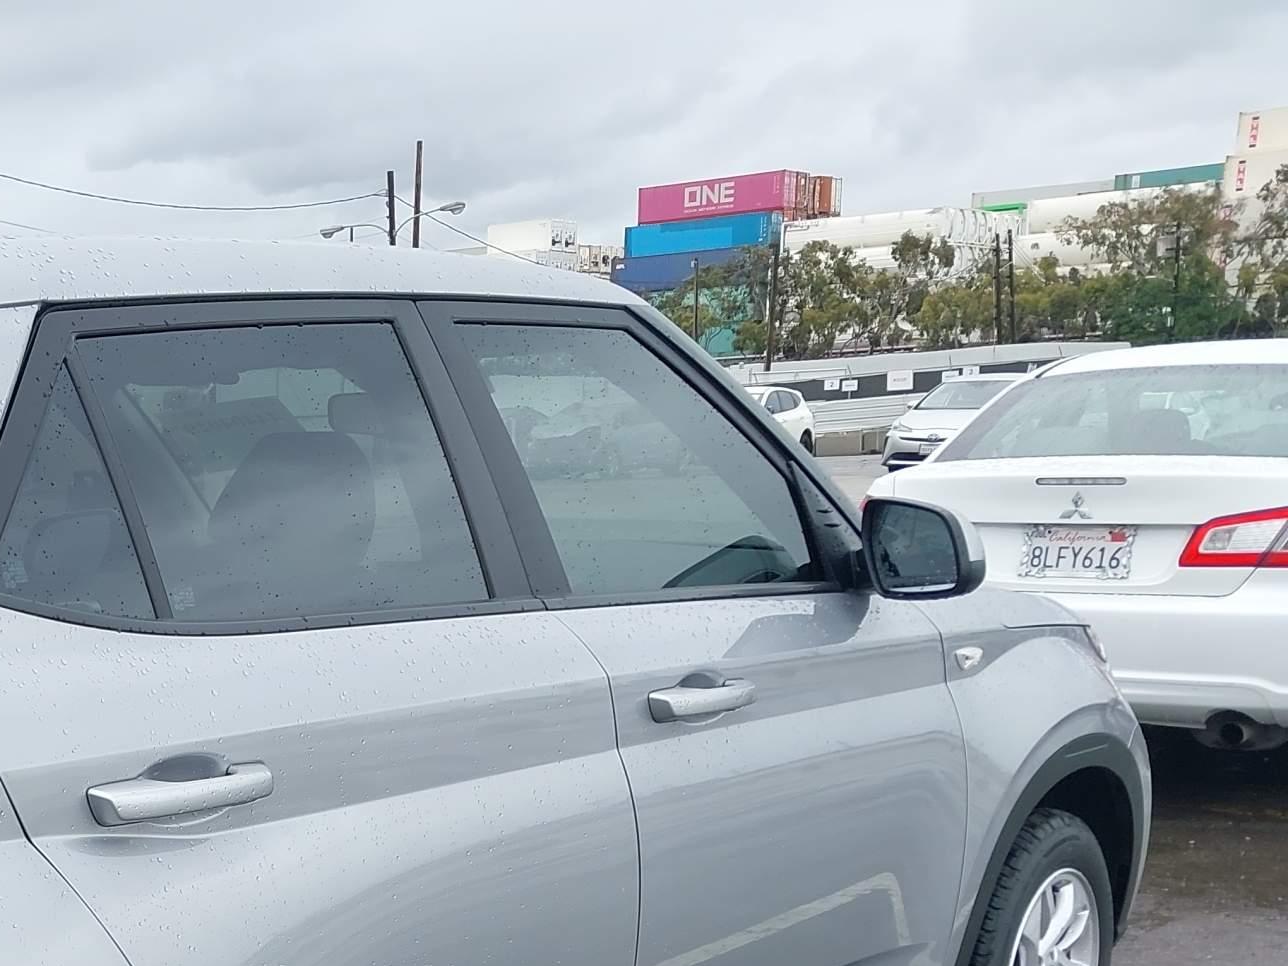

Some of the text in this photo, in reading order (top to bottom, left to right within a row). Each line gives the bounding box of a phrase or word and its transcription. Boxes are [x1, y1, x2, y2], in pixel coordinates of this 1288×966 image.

[684, 181, 735, 207] ONE
[1049, 527, 1106, 545] California
[1030, 546, 1123, 569] 8LFY616
